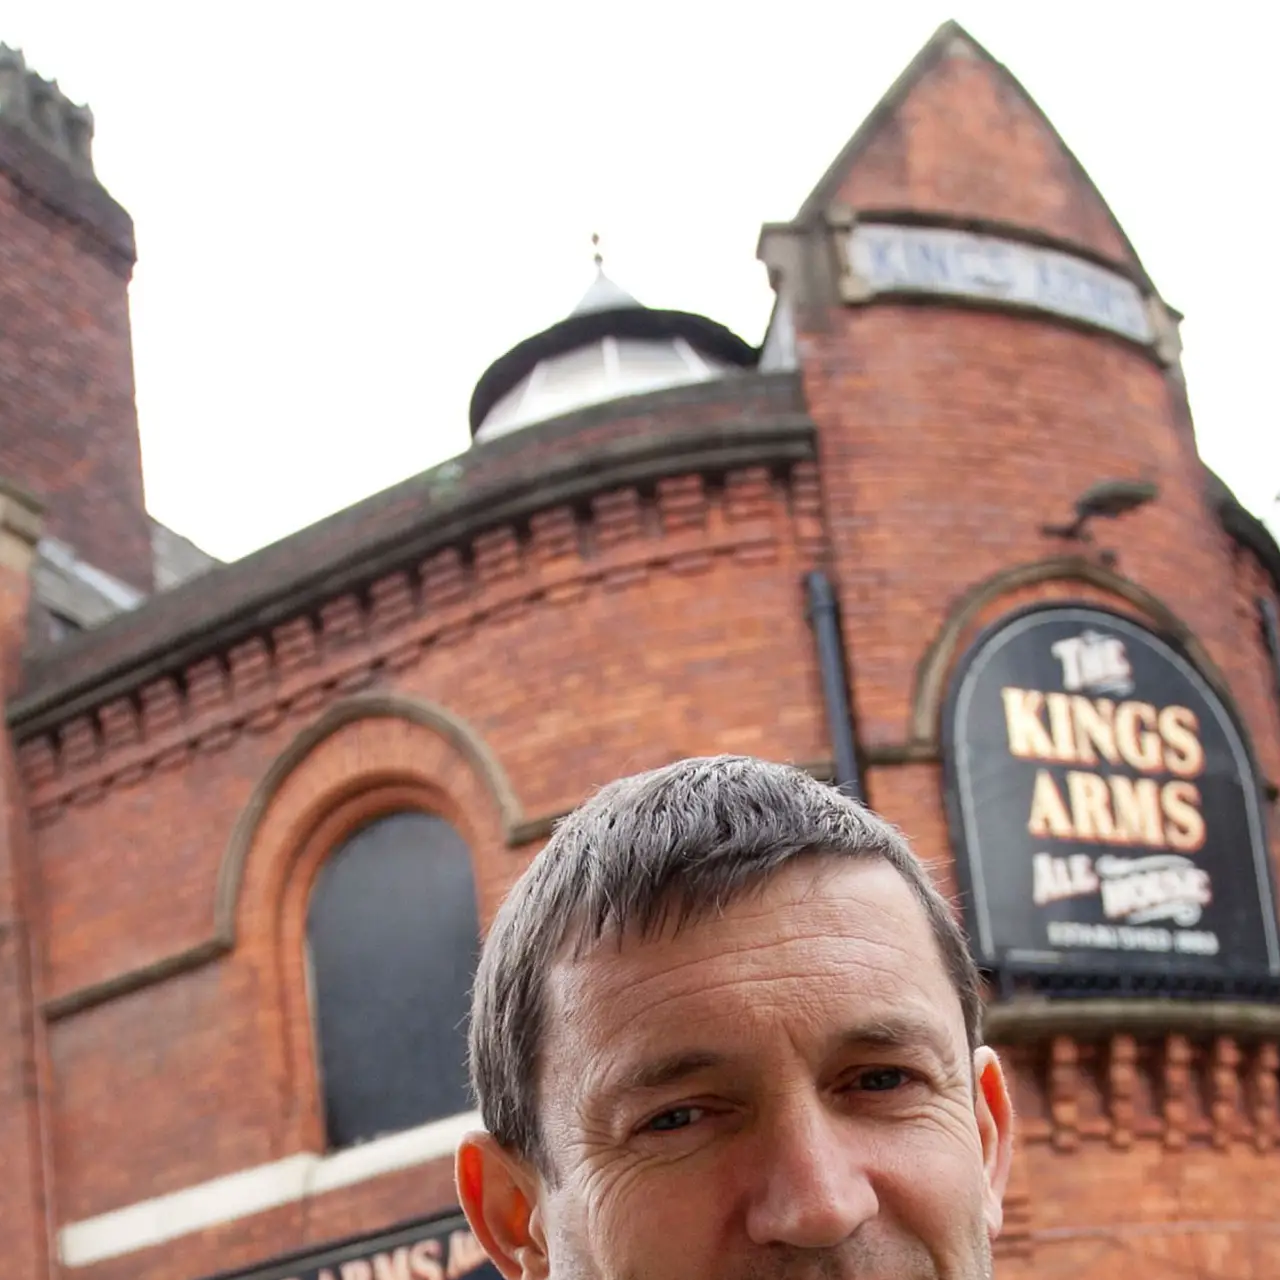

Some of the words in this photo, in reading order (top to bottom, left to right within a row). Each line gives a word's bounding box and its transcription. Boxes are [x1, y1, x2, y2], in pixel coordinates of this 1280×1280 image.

[1051, 634, 1131, 691] THE
[1001, 687, 1207, 780] KINGS
[1028, 769, 1206, 852] ARMS
